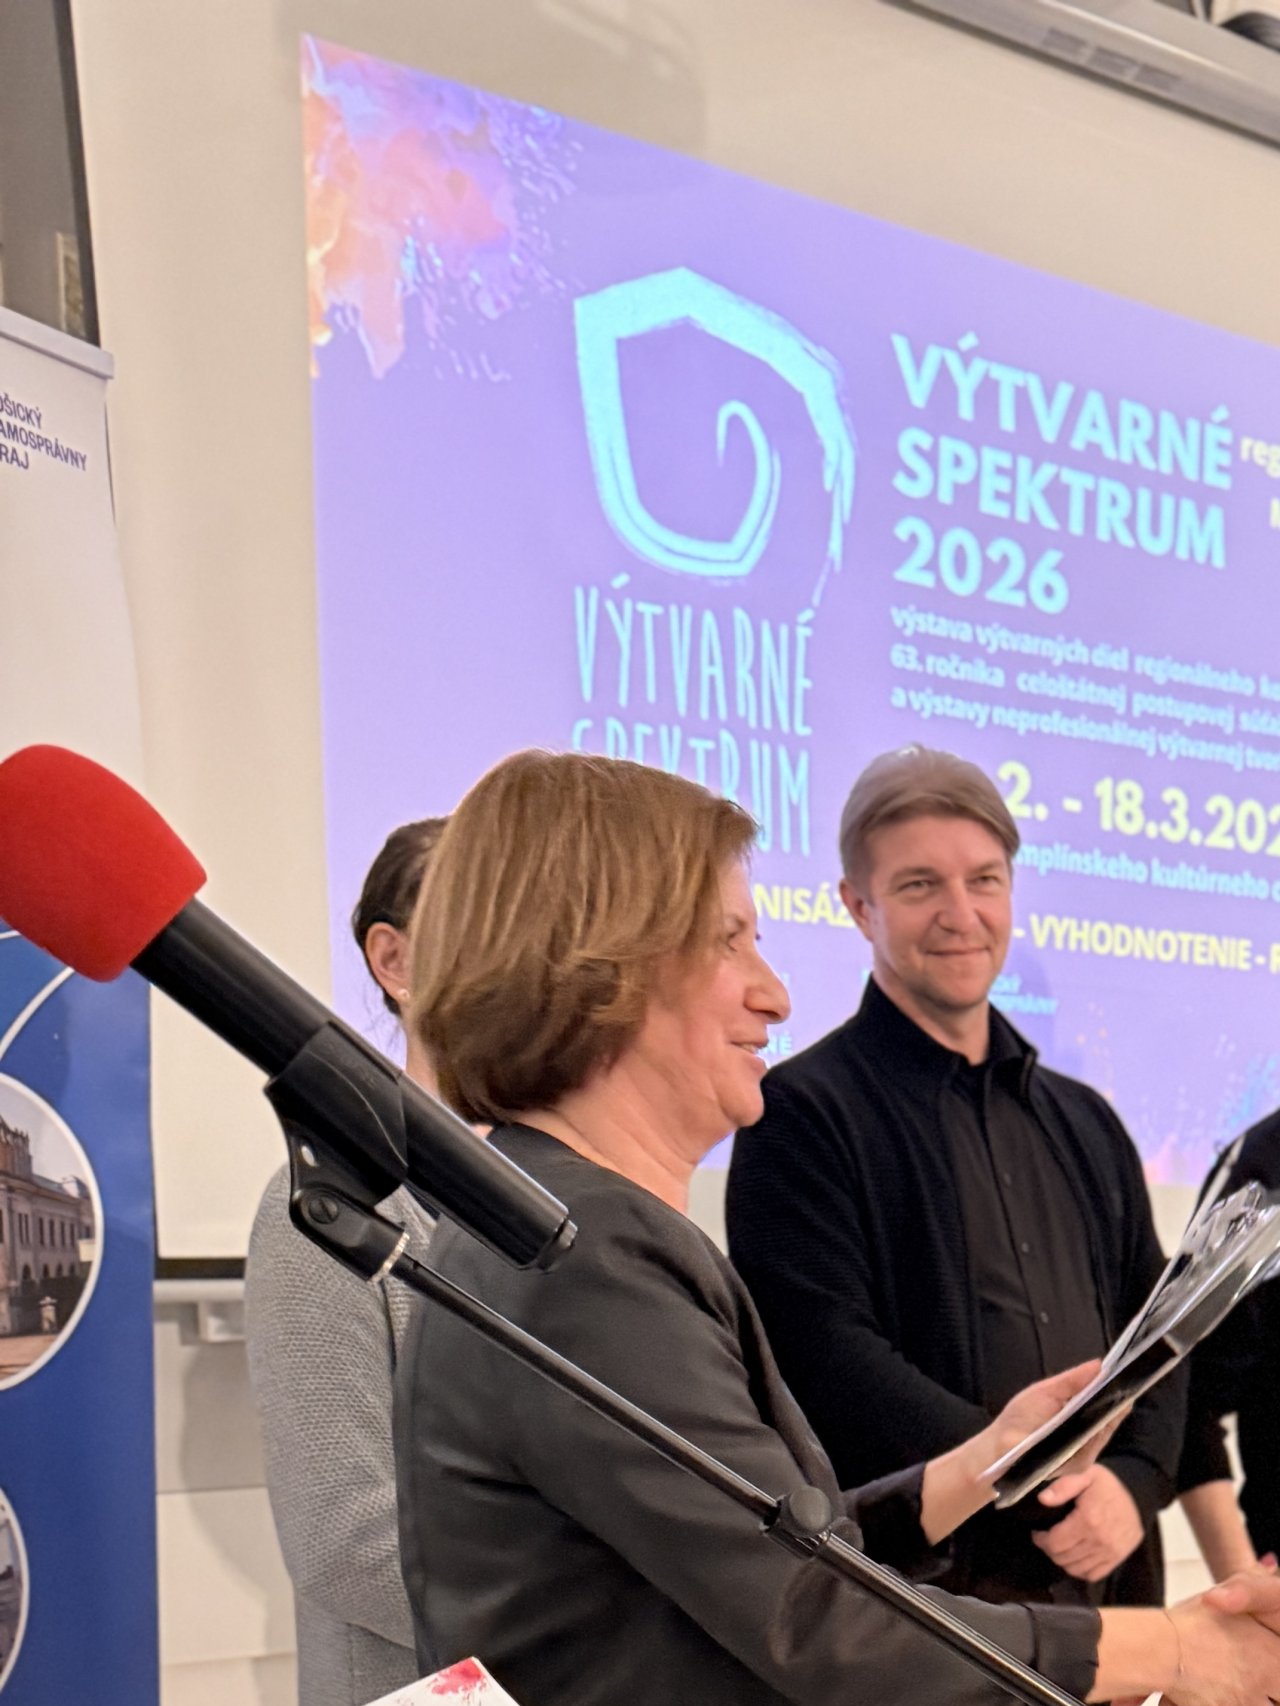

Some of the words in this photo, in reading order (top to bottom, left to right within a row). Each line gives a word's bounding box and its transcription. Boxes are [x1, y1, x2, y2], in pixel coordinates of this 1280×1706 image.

[890, 331, 1233, 491] VÝTVARNÉ
[892, 426, 1227, 571] SPEKTRUM
[892, 515, 1070, 616] 2026
[574, 572, 812, 736] VÝTVARNÉ
[890, 604, 973, 643] výstava
[975, 622, 1090, 667] výtvarných
[890, 642, 923, 674] 63.
[925, 652, 1006, 688] ročníka
[891, 685, 907, 709] a
[908, 687, 991, 730] výstavy
[1150, 856, 1269, 900] kultúrneho
[1029, 913, 1251, 971] VYHODNOTENIE
